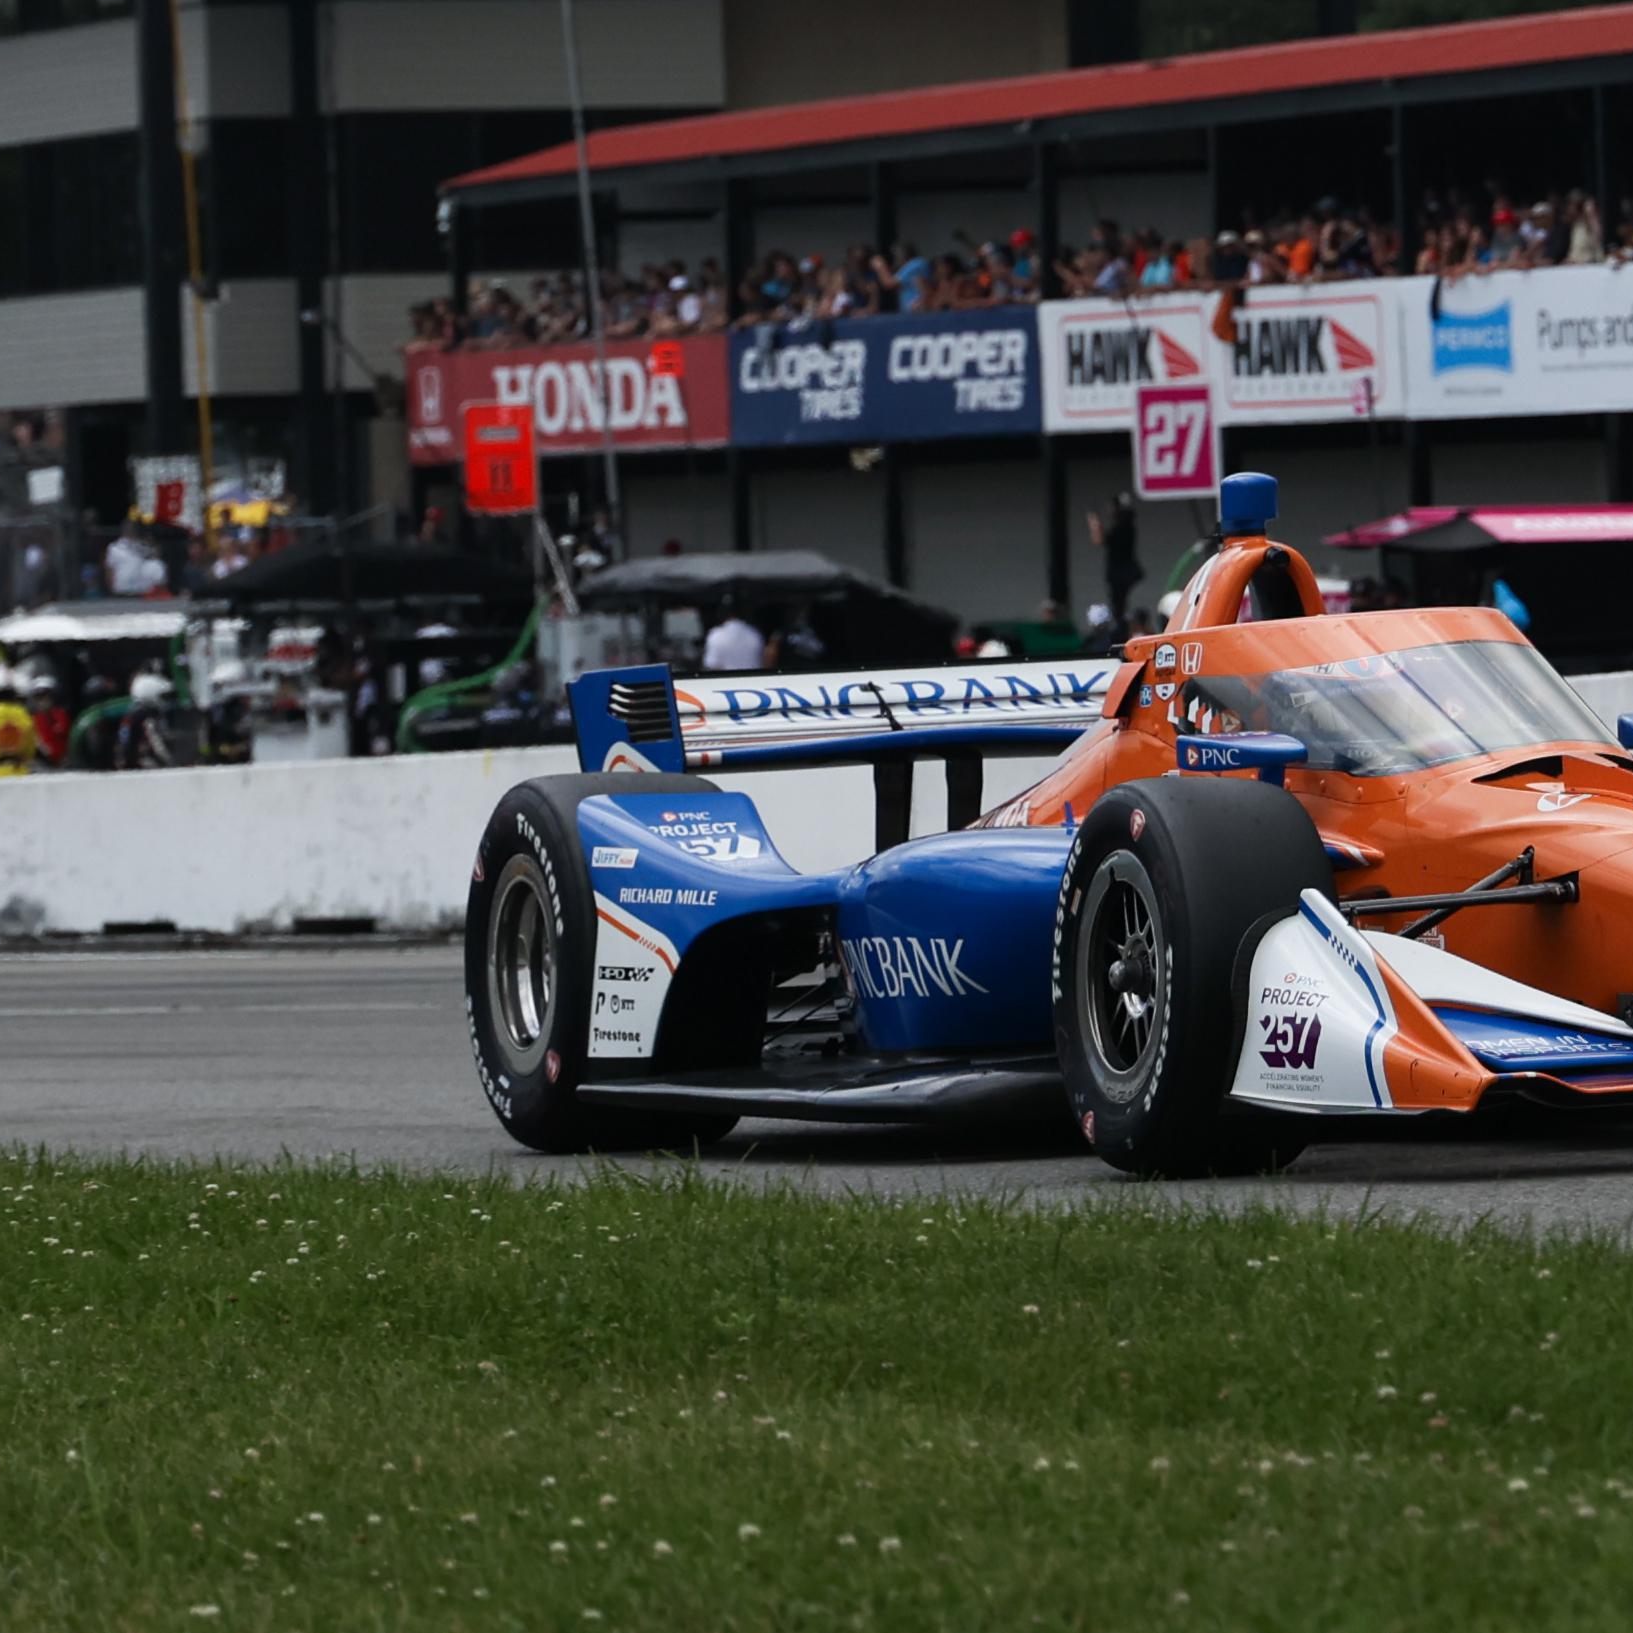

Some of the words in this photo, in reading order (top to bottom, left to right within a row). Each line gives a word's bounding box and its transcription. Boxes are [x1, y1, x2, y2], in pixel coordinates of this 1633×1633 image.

[888, 329, 1028, 382] COOPER
[1066, 327, 1154, 386] HAWK
[1233, 317, 1327, 375] HAWK
[492, 358, 688, 434] HONDA
[1144, 401, 1207, 477] 27
[1202, 748, 1240, 766] PNC
[678, 811, 711, 822] PNC
[517, 812, 564, 938] Firestone
[595, 848, 620, 864] JIFFY
[620, 887, 672, 904] RICHARD
[675, 889, 718, 906] MILLE
[1052, 837, 1083, 1006] Firestone
[599, 966, 626, 980] HPD
[1261, 987, 1330, 1008] PROJECT
[594, 1027, 641, 1043] Firestone
[1142, 944, 1174, 1112] Firestone
[1259, 1011, 1318, 1064] 257
[1557, 1035, 1589, 1045] IN
